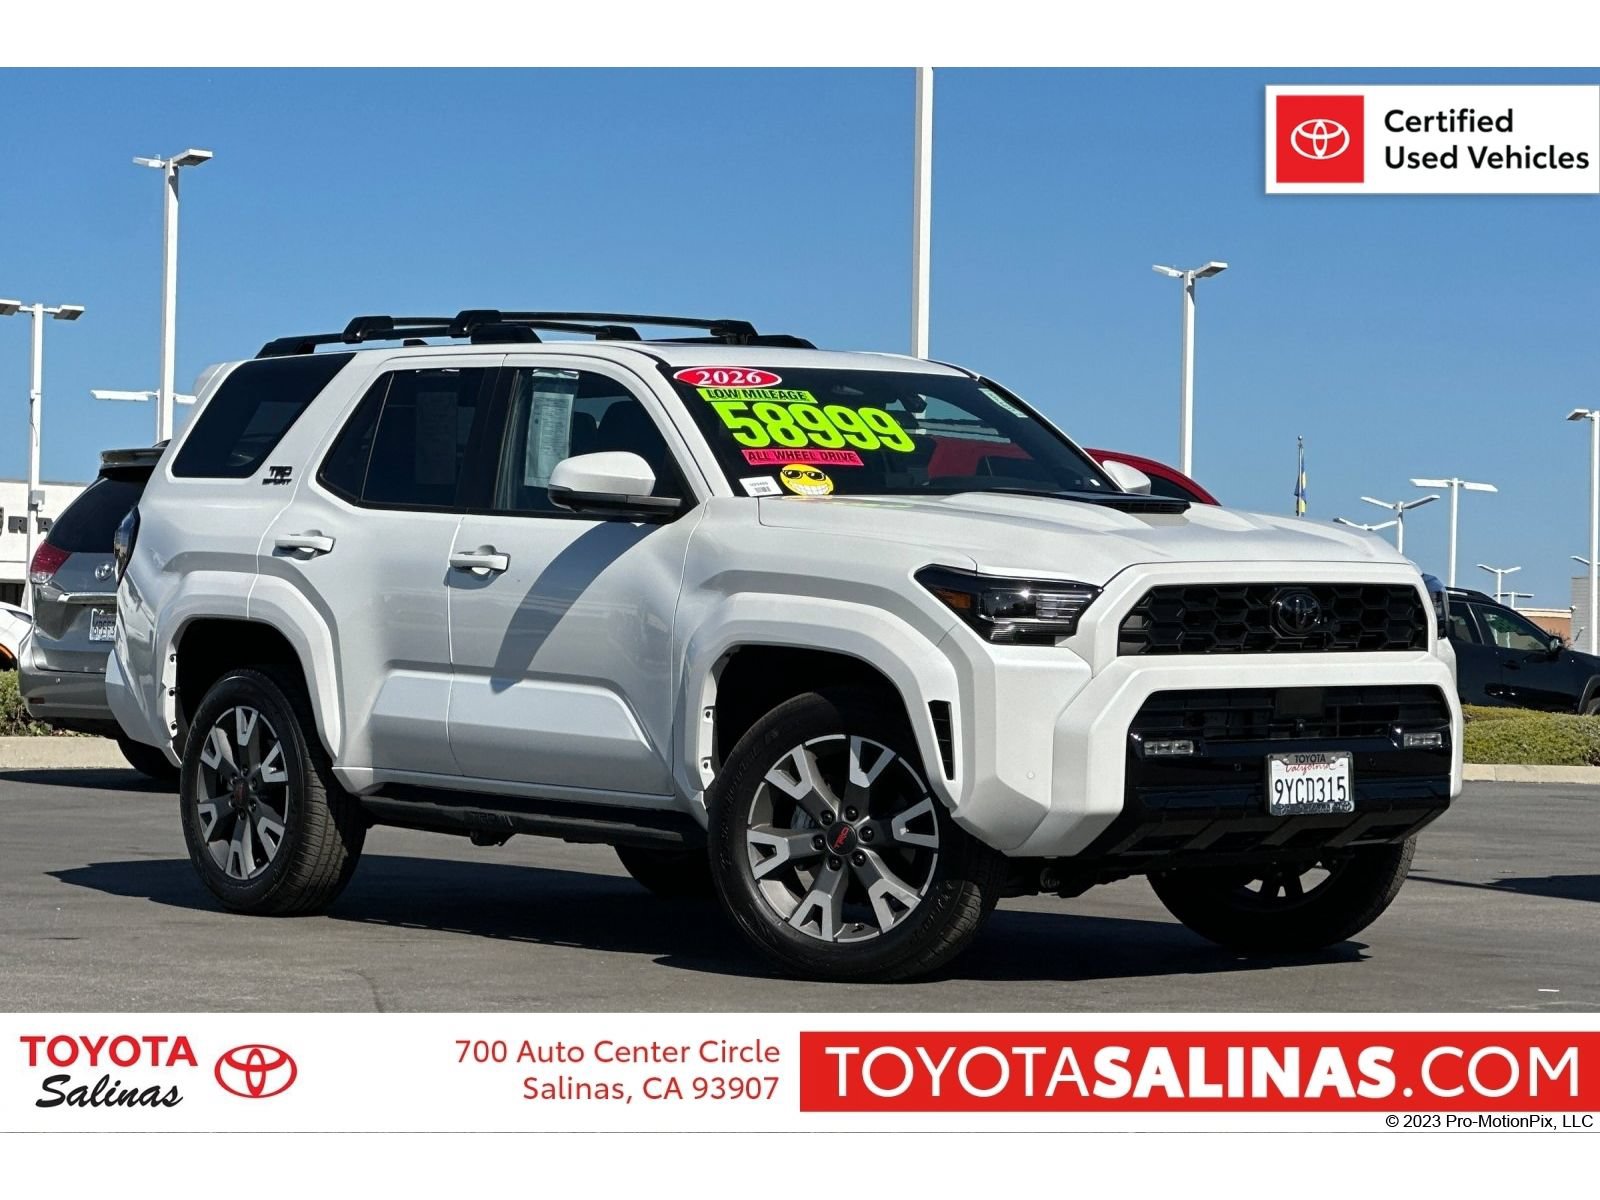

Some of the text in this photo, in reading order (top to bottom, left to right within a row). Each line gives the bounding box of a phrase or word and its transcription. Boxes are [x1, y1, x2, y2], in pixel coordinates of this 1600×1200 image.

[696, 369, 763, 386] 2026
[708, 388, 807, 401] LOW MILEAGE
[710, 401, 916, 453] 58999
[748, 450, 856, 463] ALL WHEEL DRIVE
[1294, 753, 1327, 764] TOYOTA
[1274, 776, 1346, 804] 9YCD315
